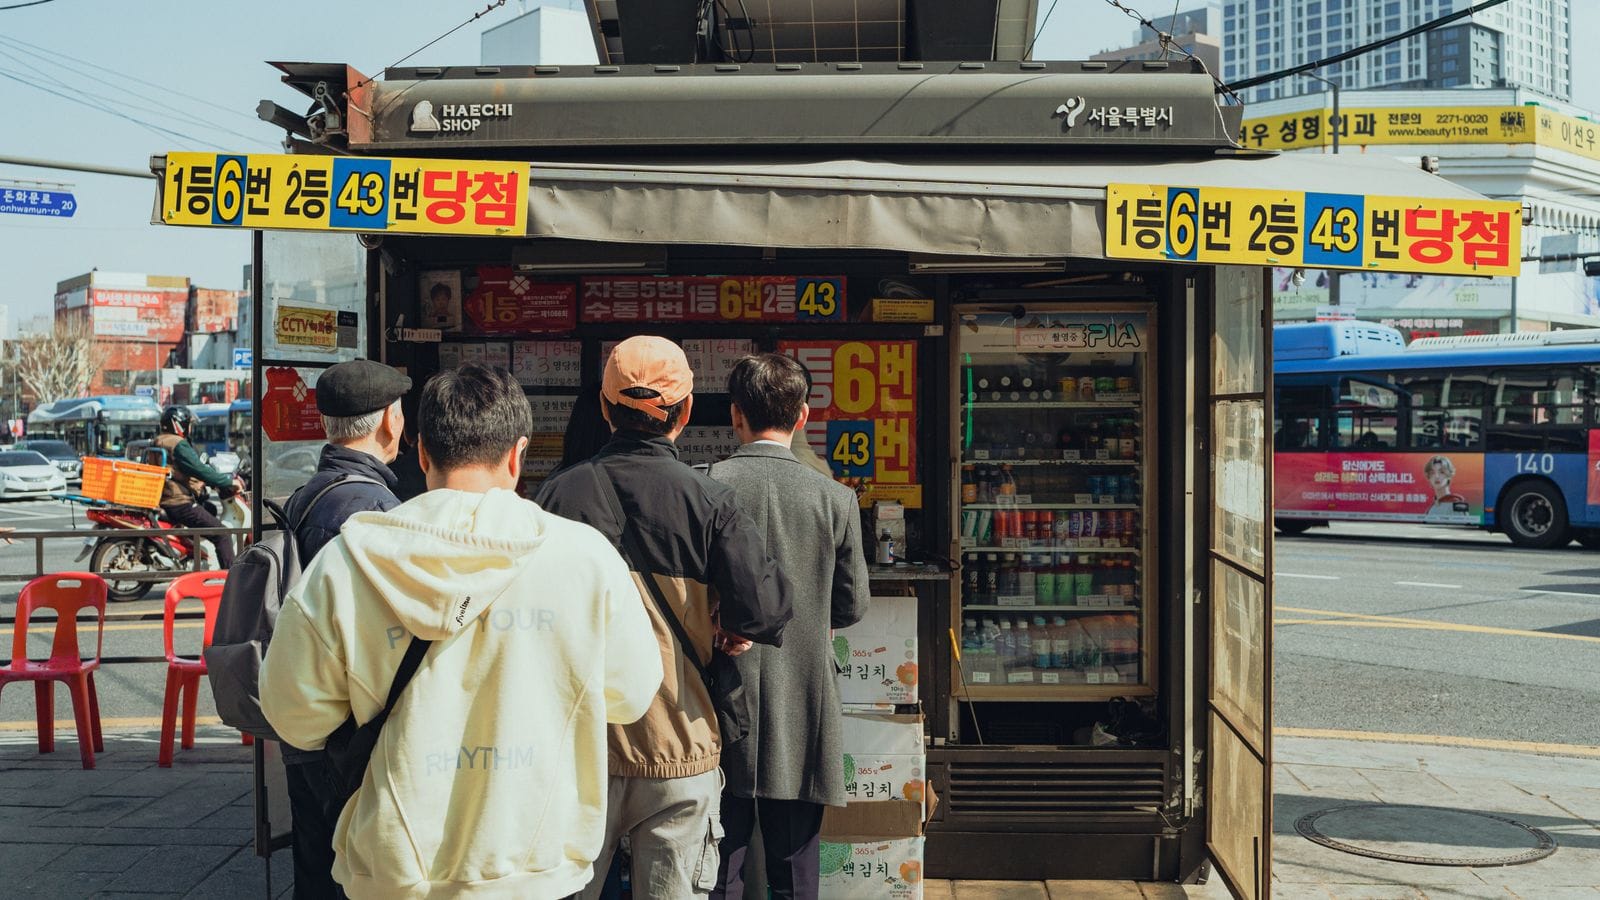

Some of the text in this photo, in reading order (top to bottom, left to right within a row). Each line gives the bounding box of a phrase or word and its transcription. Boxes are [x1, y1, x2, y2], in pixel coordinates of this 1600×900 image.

[442, 104, 513, 117] HAECHI
[1088, 106, 1173, 126] 서울특별시
[442, 119, 481, 131] SHOP
[1388, 113, 1421, 125] 전문의
[1436, 114, 1488, 124] 2271-0020
[1388, 126, 1488, 137] www.beauty119.net
[1561, 121, 1596, 151] 이선우
[3, 190, 52, 205] 돈화문로
[61, 200, 73, 210] 20
[584, 281, 684, 298] 자동5번
[481, 291, 520, 323] 1등
[584, 301, 684, 319] 수동1번
[281, 317, 309, 333] CCTV
[1051, 332, 1078, 343] 촬영중
[1515, 453, 1554, 474] 140
[478, 608, 556, 633] YOUR
[425, 744, 534, 777] RHYTHM
